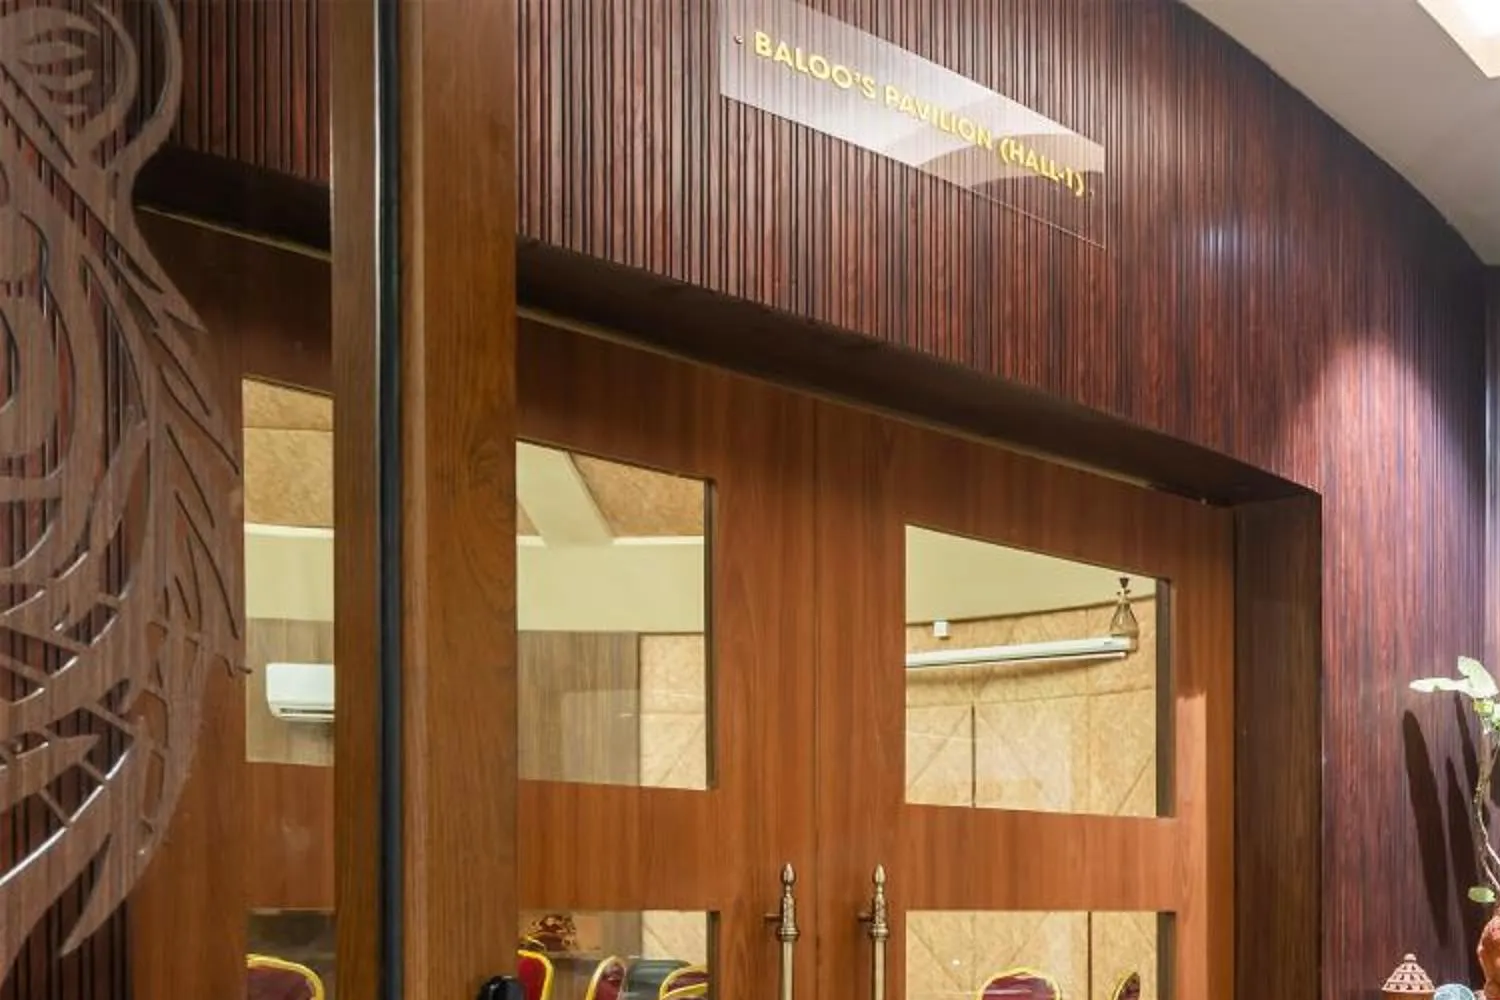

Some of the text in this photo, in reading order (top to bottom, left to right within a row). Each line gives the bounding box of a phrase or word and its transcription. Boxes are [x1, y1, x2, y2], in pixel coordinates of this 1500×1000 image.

[755, 32, 1085, 196] BALOO'S PAVILION (HALL-1)
